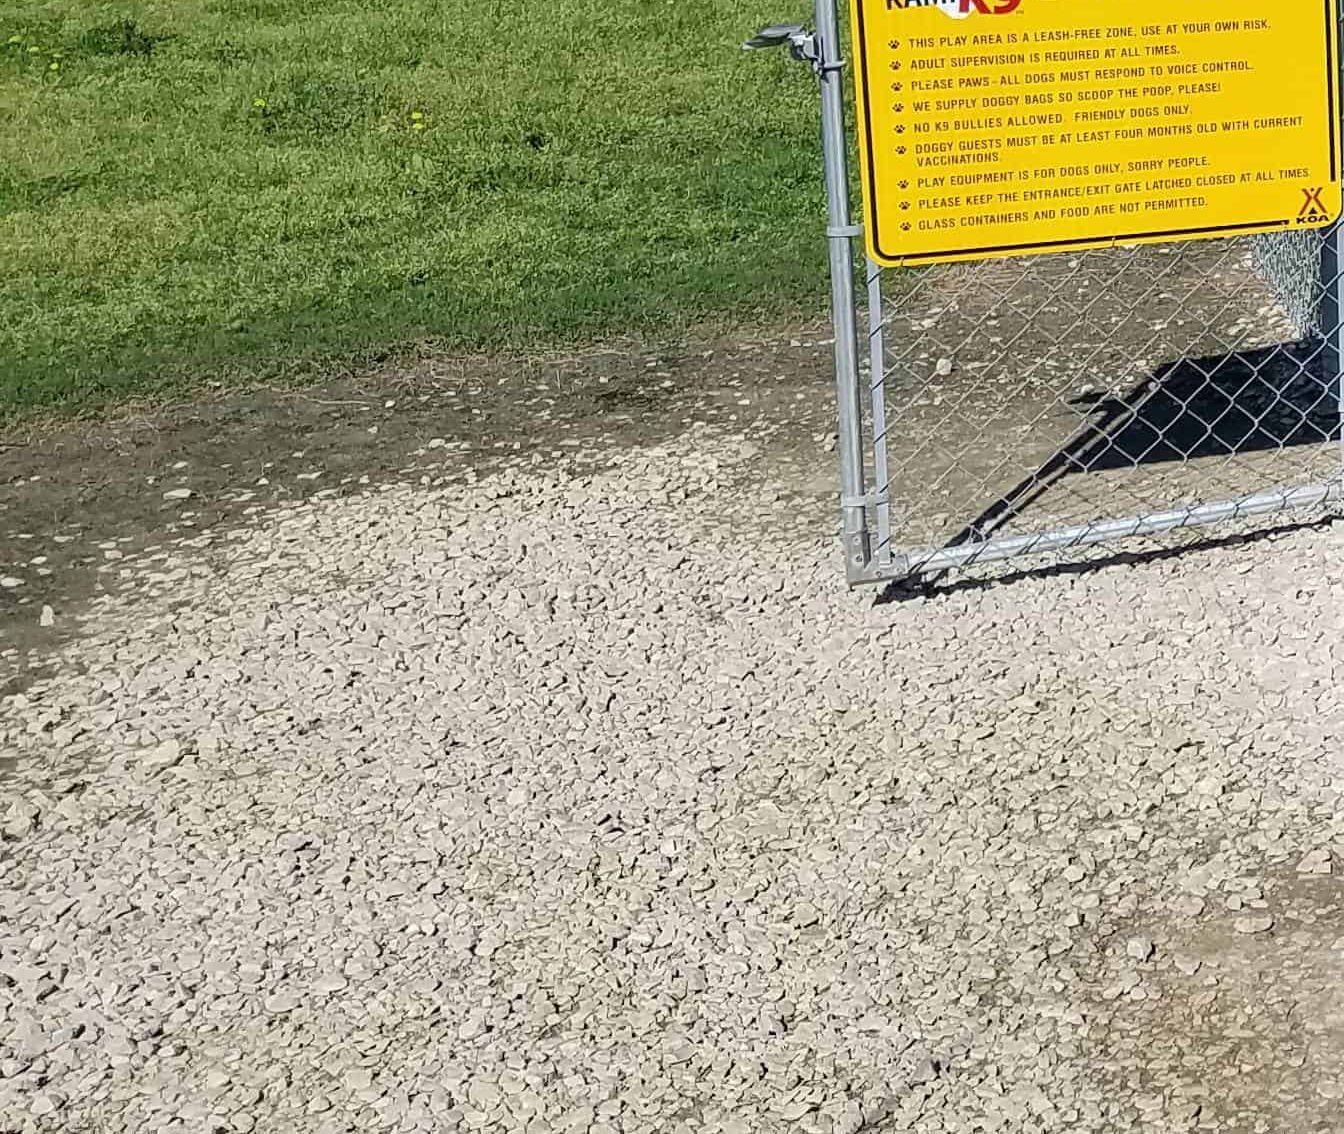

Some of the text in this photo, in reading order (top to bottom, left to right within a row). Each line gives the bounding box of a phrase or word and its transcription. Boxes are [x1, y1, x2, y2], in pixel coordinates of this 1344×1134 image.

[909, 37, 935, 48] THIS
[940, 36, 967, 47] PLAY
[973, 34, 1002, 45] AREA
[1008, 33, 1017, 43] IS
[1023, 33, 1029, 42] A
[1034, 29, 1101, 42] LEASH-FREE
[1141, 26, 1161, 36] USE
[1166, 24, 1177, 35] AT
[1182, 23, 1210, 34] YOUR
[1215, 21, 1239, 32] OWN
[1244, 19, 1271, 30] RISK.
[910, 45, 1180, 70] ADULT SUPERVISION IS REQUIRED AT ALL TIMES.
[911, 79, 953, 91] PLEASE
[959, 76, 990, 87] PAWS
[1000, 75, 1020, 85] ALL
[1025, 72, 1055, 84] DOGS
[1060, 70, 1089, 82] MUST
[1095, 68, 1145, 80] RESPOND
[1150, 66, 1163, 76] TO
[1168, 63, 1198, 75] VOICE
[913, 101, 931, 112] WE
[936, 98, 977, 111] SUPPLY
[982, 96, 1020, 108] DOGGY
[1025, 93, 1053, 105] BAGS
[1059, 92, 1072, 102] SO
[1078, 89, 1114, 101] SCOOP
[1119, 89, 1139, 98] THE
[914, 122, 930, 133] NO
[935, 121, 949, 132] K9
[954, 117, 1003, 130] BULLIES
[1075, 108, 1126, 121] FRIENDLY
[1130, 106, 1159, 117] DOGS
[915, 116, 1303, 154] DOGGY GUESTS MUST BE AT LEAST FOUR MONTHS OLD WITH CURRENT
[918, 177, 945, 188] PLAY
[951, 172, 1014, 185] EQUIPMENT
[1019, 169, 1029, 180] IS
[1034, 168, 1056, 179] FOR
[1060, 166, 1089, 177] DOGS
[1128, 160, 1164, 171] SORRY
[1168, 156, 1211, 168] PEOPLE.
[919, 196, 961, 209] PLEASE
[966, 194, 993, 205] KEEP
[999, 192, 1019, 203] THE
[1023, 184, 1111, 200] ENTRANCE/EXIT
[1115, 181, 1142, 193] GATE
[1146, 178, 1192, 190] LATCHED
[1196, 174, 1235, 187] CLOSED
[1240, 173, 1251, 182] AT
[1256, 171, 1274, 181] ALL
[918, 196, 1208, 230] GLASS CONTAINERS AND FOOD ARE NOT PERMITTED.
[1296, 215, 1329, 224] KOA
